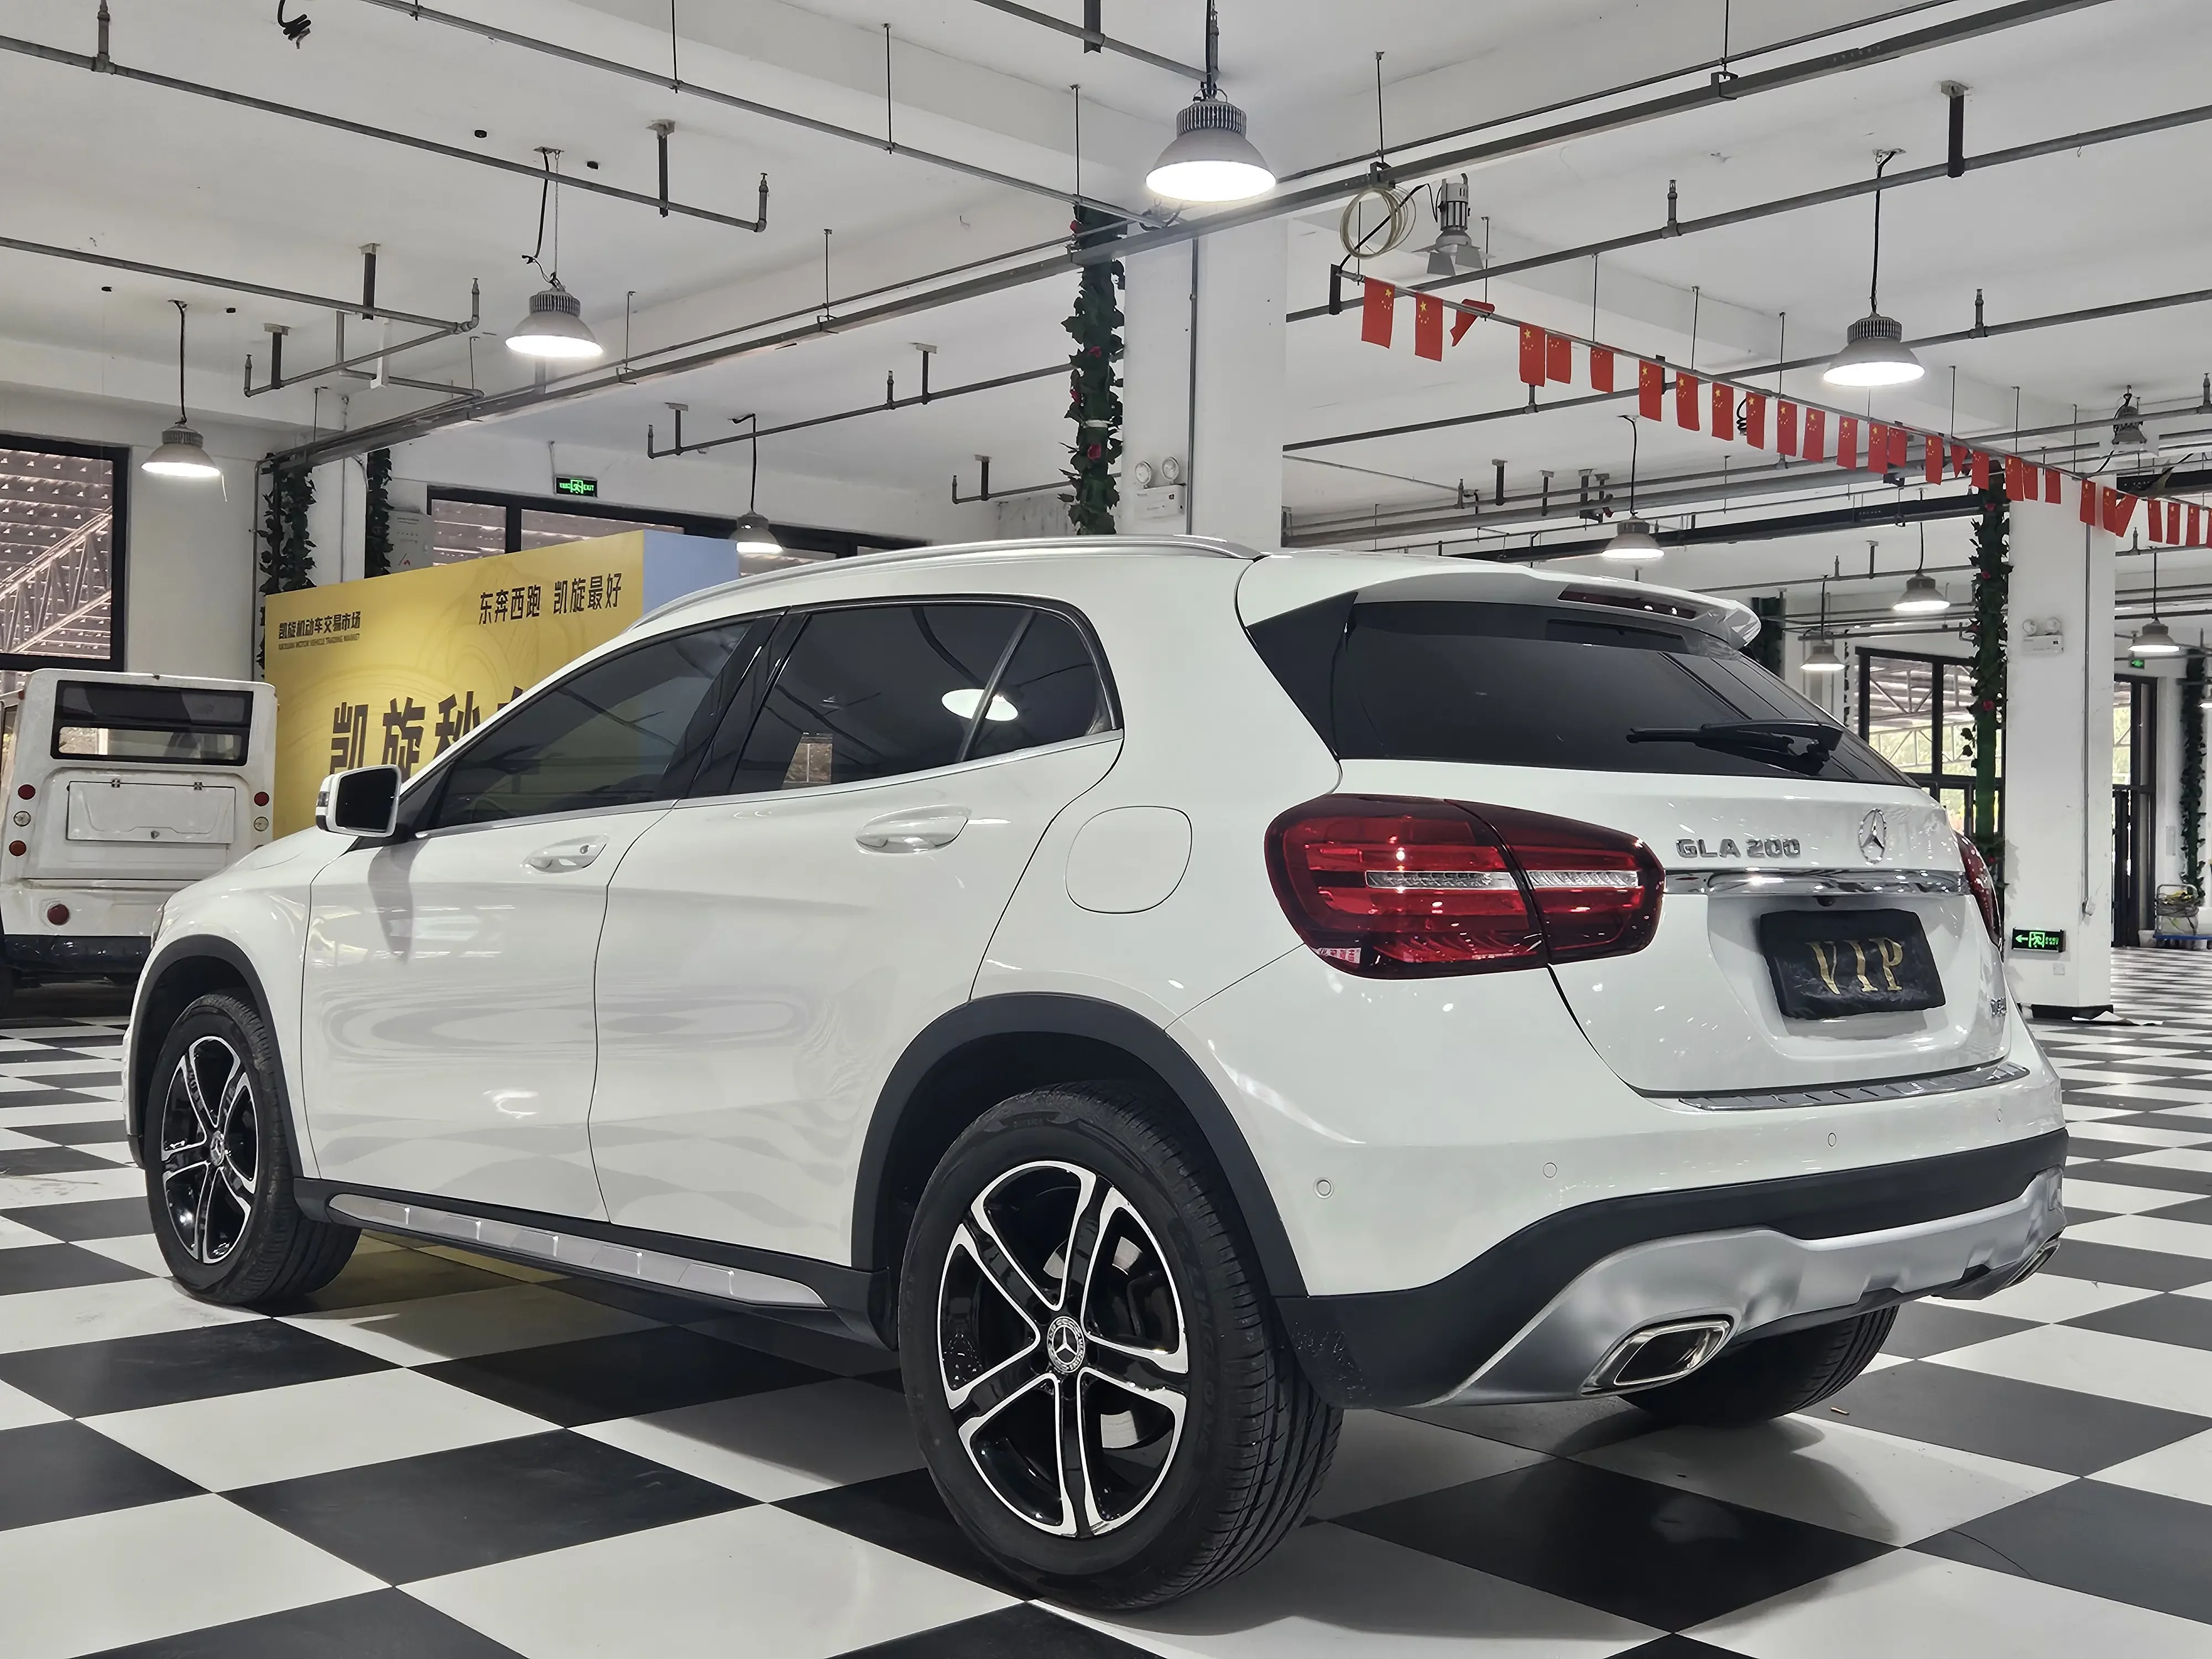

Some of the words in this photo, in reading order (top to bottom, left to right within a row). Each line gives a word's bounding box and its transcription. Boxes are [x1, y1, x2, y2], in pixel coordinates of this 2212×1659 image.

[279, 611, 361, 639] 凯旋机动车交易市场
[479, 585, 541, 625] 东奔西跑
[553, 573, 622, 614] 凯旋最好
[330, 686, 523, 783] 凯旋秒
[1676, 838, 1741, 858] GLA
[1746, 838, 1801, 858] 200
[1805, 937, 1903, 995] VIP
